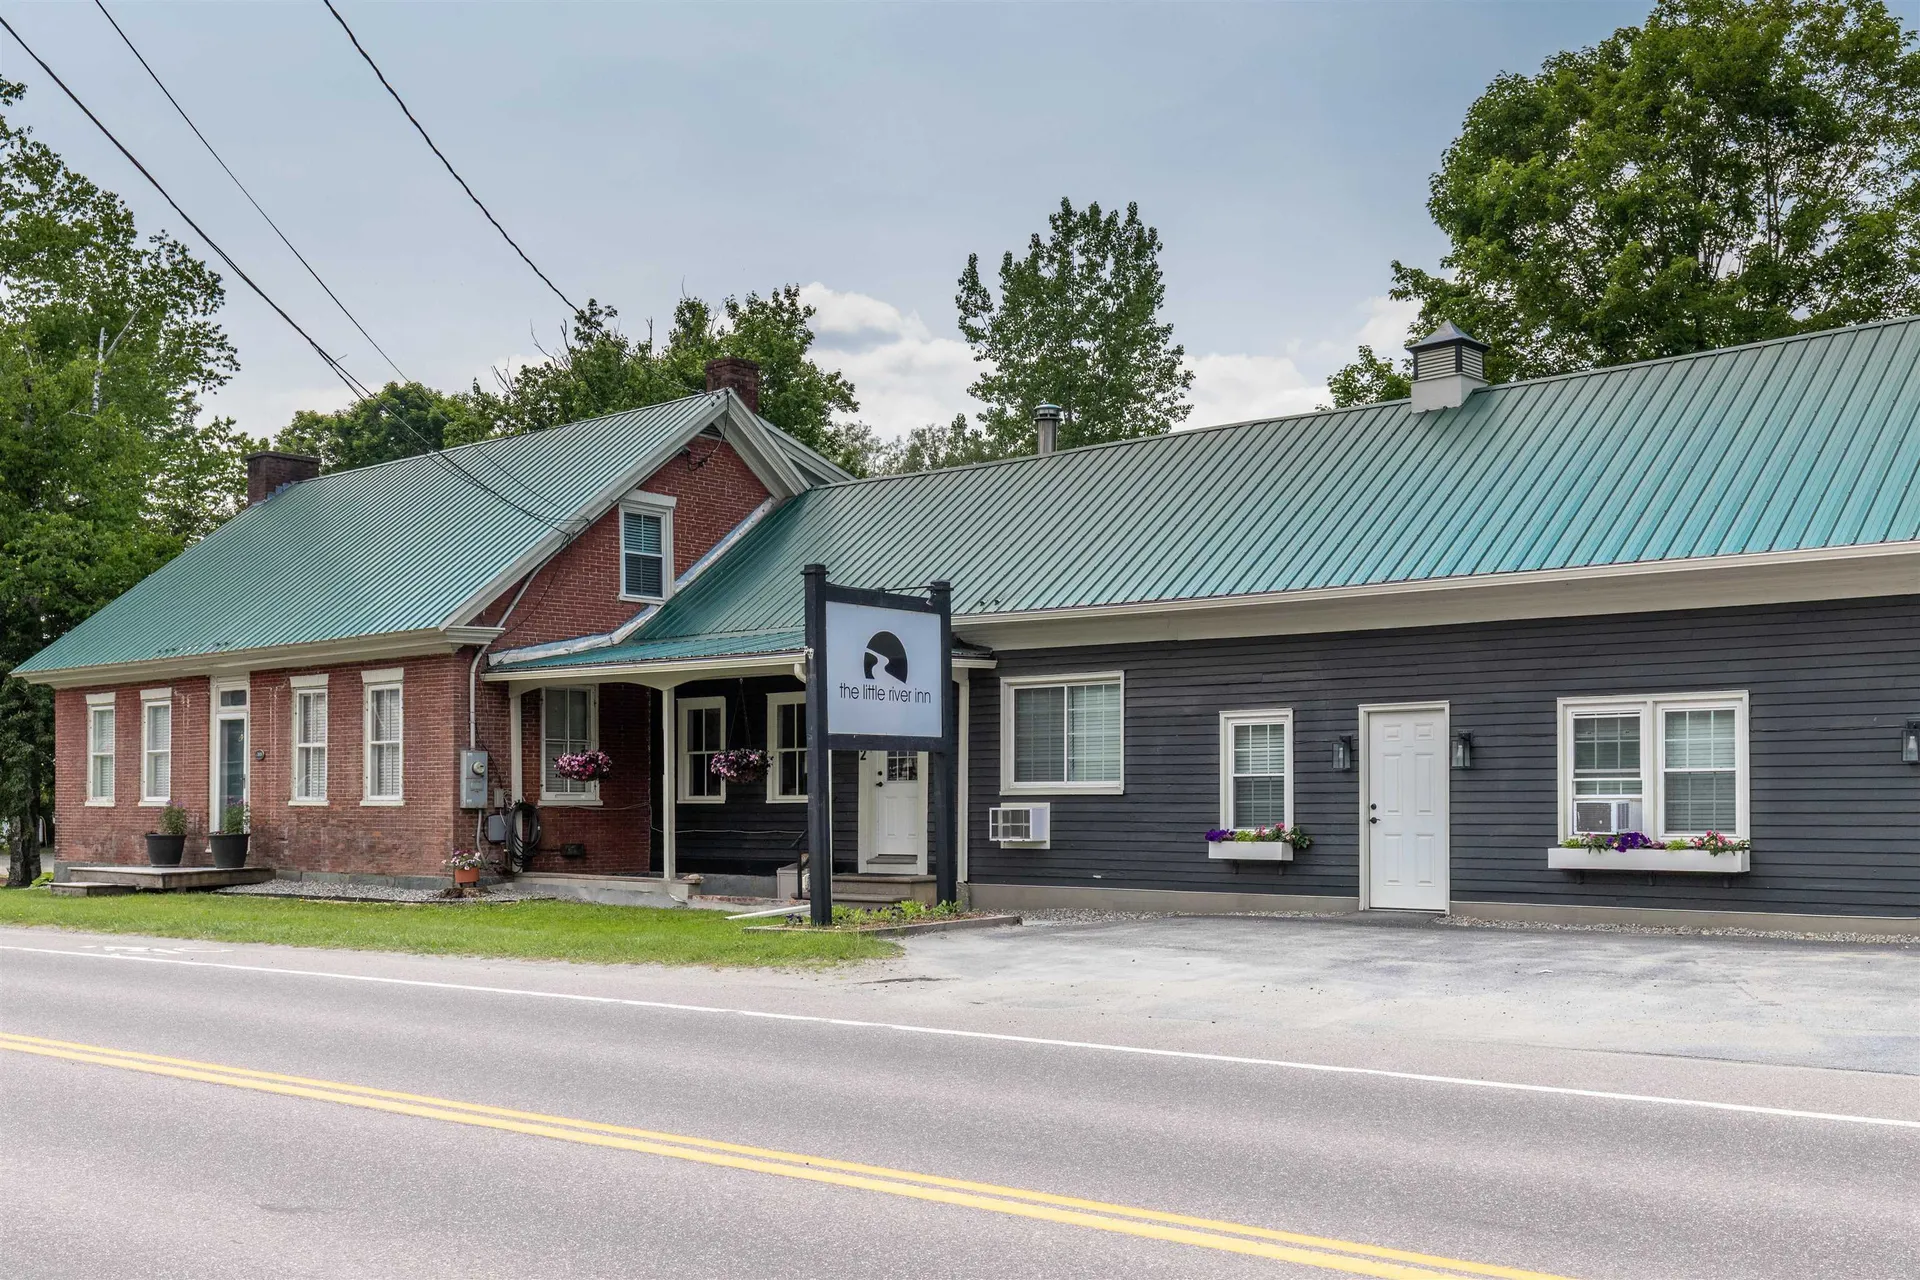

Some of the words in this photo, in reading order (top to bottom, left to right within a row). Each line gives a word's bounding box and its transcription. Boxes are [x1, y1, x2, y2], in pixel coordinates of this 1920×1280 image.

[839, 682, 860, 700] the
[863, 683, 886, 701] little
[888, 686, 912, 703] river
[914, 687, 932, 704] inn
